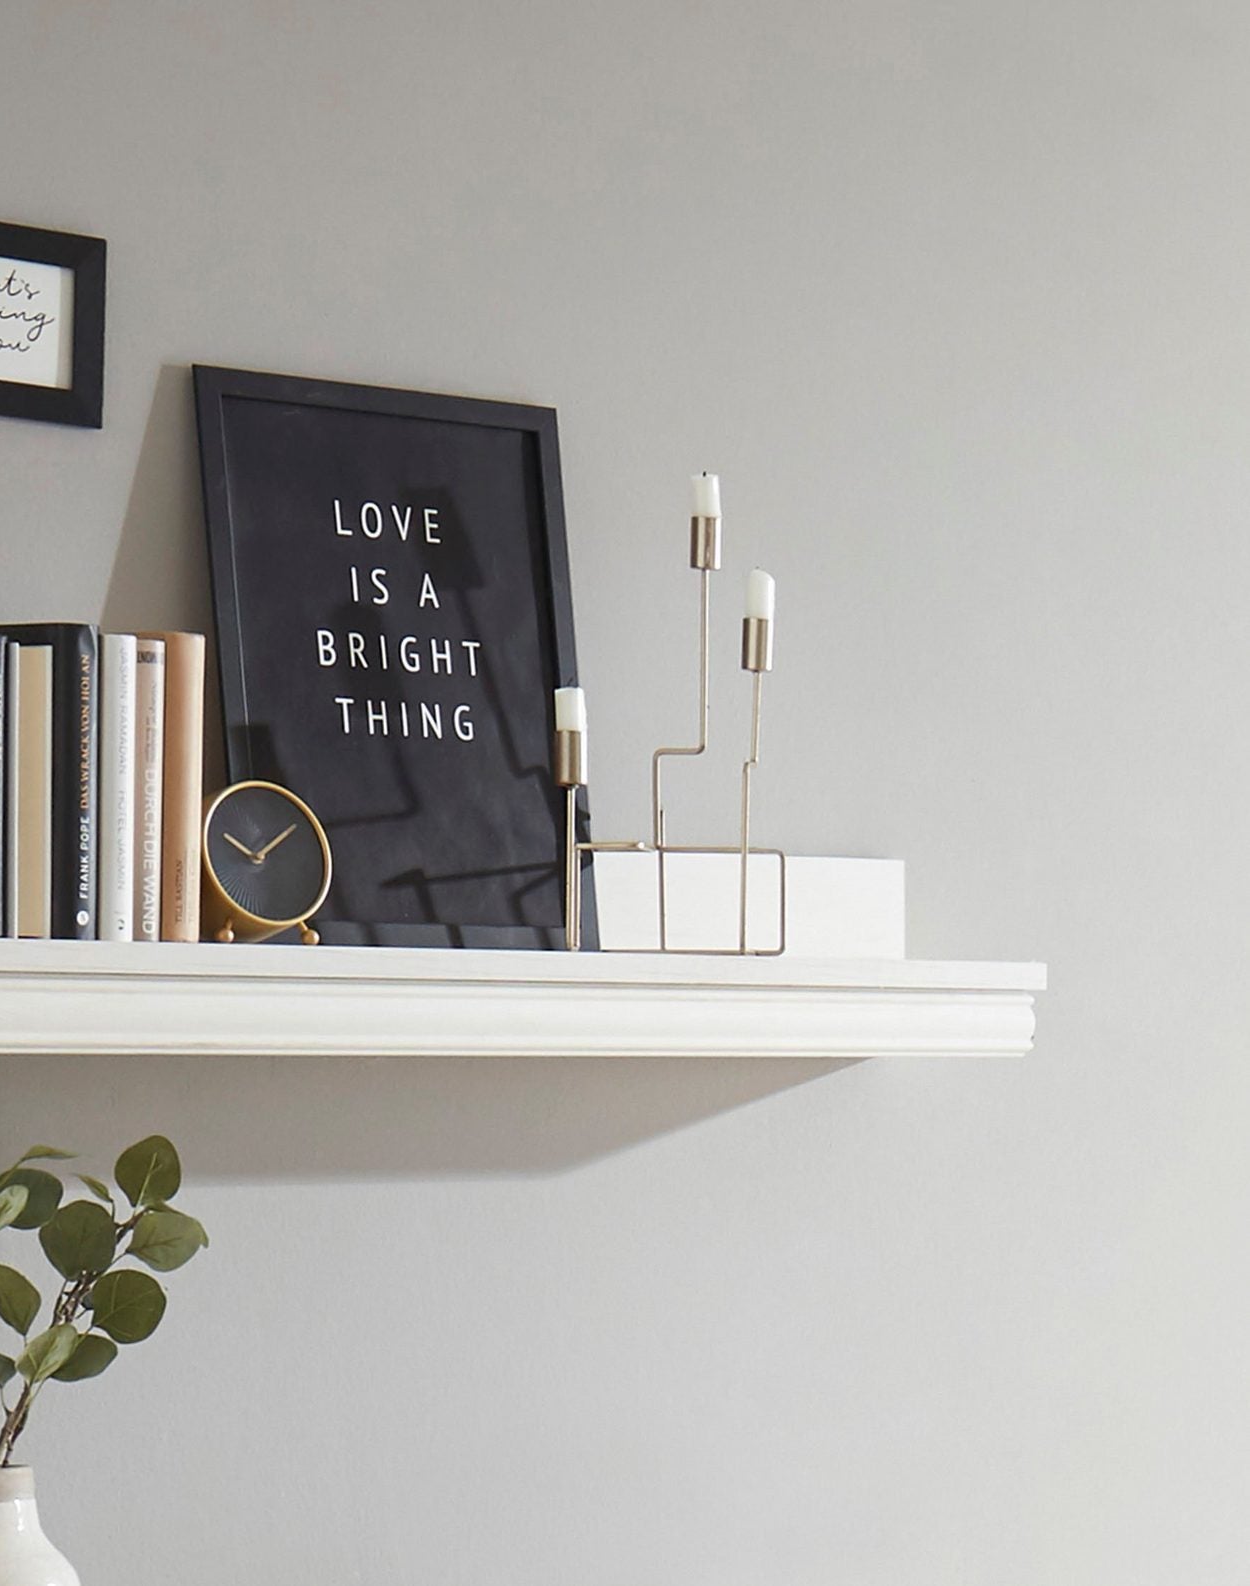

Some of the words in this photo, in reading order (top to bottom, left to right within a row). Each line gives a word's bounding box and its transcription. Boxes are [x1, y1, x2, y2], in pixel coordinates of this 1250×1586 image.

[334, 499, 441, 544] LOVE
[350, 566, 389, 605] IS
[419, 573, 440, 609] A
[81, 654, 91, 673] AN
[119, 647, 129, 700] JASMIN
[317, 629, 481, 676] BRIGHT
[81, 676, 91, 701] HOI
[81, 704, 90, 732] VON
[118, 705, 128, 775] RAMADAN
[335, 697, 475, 742] THING
[80, 735, 90, 782] WRACK
[80, 784, 90, 809] DAS
[144, 769, 158, 839] DURCH
[79, 816, 90, 851] POPE
[143, 841, 157, 870] DIE
[78, 854, 90, 900] FRANK
[141, 875, 156, 934] WAND
